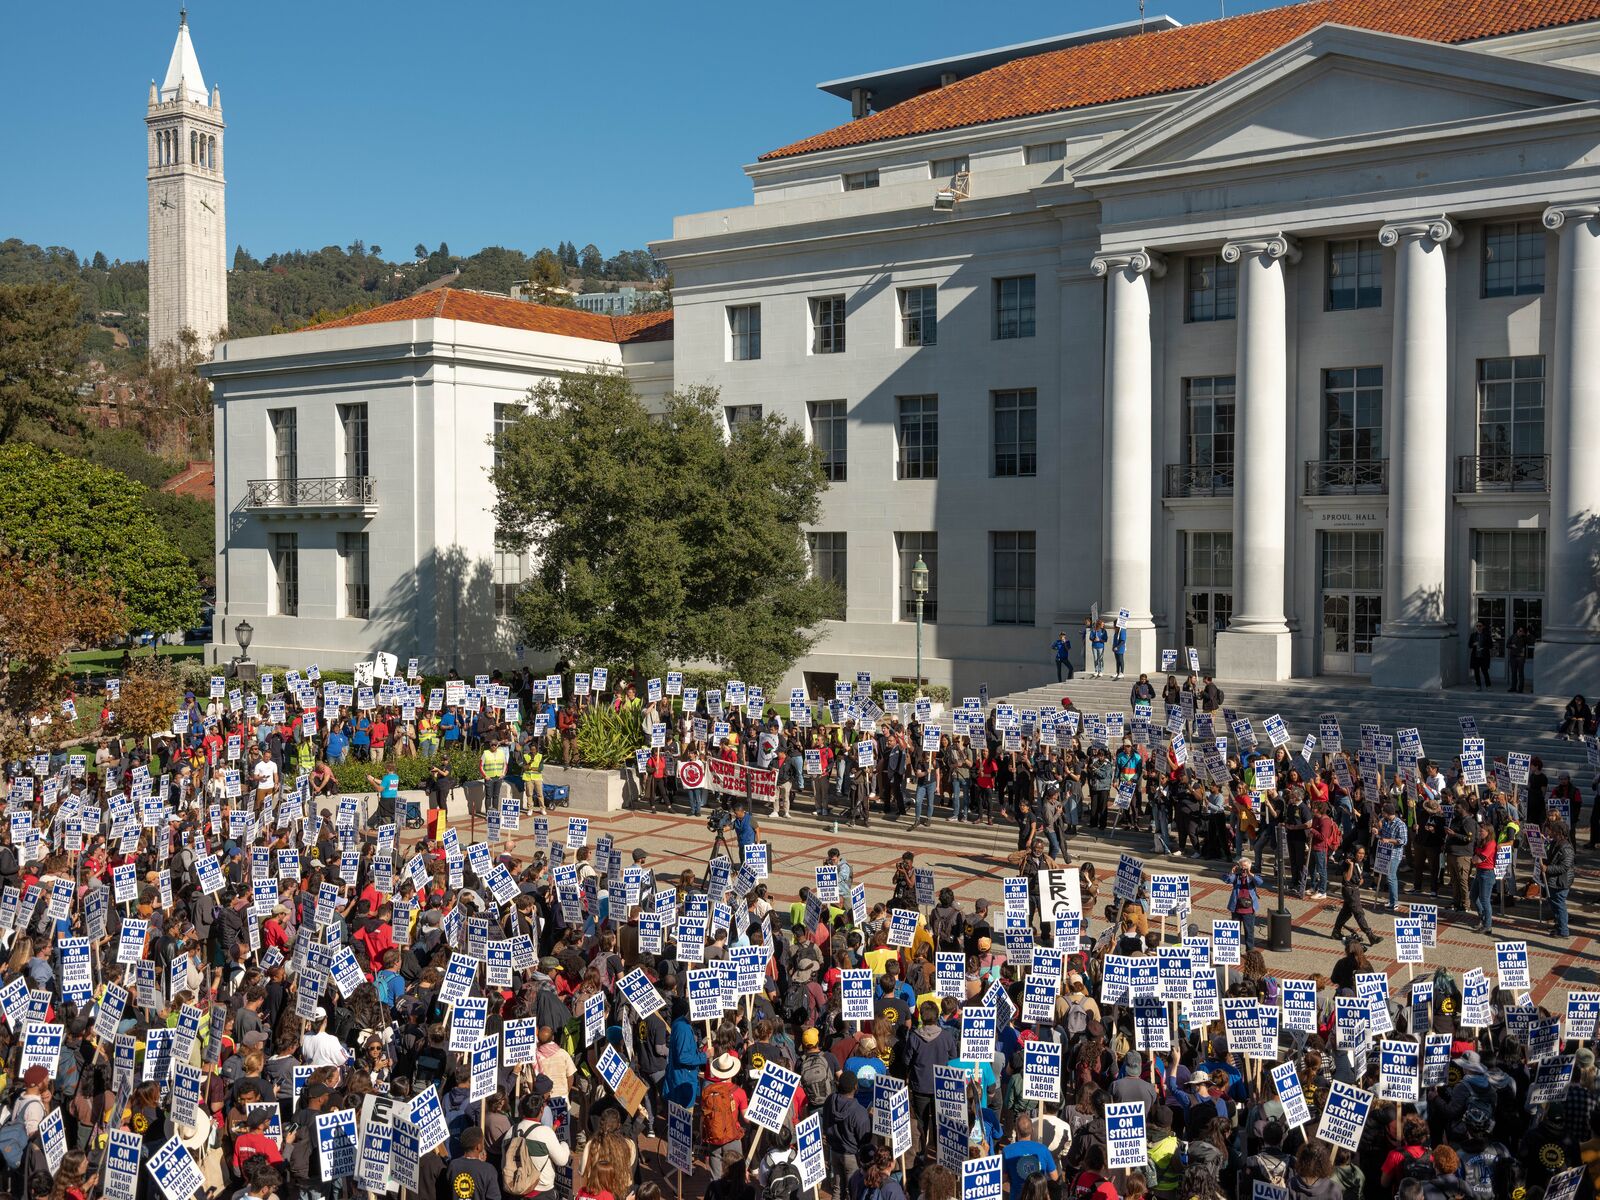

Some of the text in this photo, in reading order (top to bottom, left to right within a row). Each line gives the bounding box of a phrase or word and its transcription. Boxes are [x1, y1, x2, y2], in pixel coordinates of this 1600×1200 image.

[115, 865, 134, 874] UAW
[124, 920, 146, 928] UAW
[680, 918, 704, 927] UAW
[1214, 921, 1238, 929] UAW
[121, 936, 144, 944] STRIKE
[679, 934, 703, 943] STRIKE
[1159, 948, 1189, 957] UAW
[1497, 943, 1525, 951] UAW
[1499, 961, 1527, 969] STRIKE
[688, 970, 717, 981] UAW
[1160, 969, 1190, 977] STRIKE
[698, 981, 710, 989] ON
[690, 988, 719, 999] STRIKE
[843, 989, 872, 998] STRIKE
[695, 997, 717, 1006] UNFAIR
[696, 1003, 716, 1011] LABOR
[1135, 998, 1166, 1006] UAW
[1224, 999, 1257, 1008] UAW
[692, 1008, 721, 1019] PRACTICE
[964, 1008, 995, 1017] UAW
[1145, 1009, 1158, 1017] ON
[506, 1019, 534, 1030] UAW
[1137, 1018, 1167, 1026] STRIKE
[1227, 1019, 1258, 1028] STRIKE
[515, 1029, 526, 1037] ON
[964, 1029, 994, 1037] STRIKE
[473, 1036, 497, 1052] UAW
[506, 1036, 534, 1046] STRIKE
[1229, 1042, 1260, 1050] PRACTICE
[509, 1044, 531, 1053] UNFAIR
[1026, 1042, 1060, 1054] UAW
[1382, 1042, 1417, 1054] UAW
[480, 1050, 490, 1061] ON
[510, 1050, 530, 1058] LABOR
[962, 1052, 993, 1060] PRACTICE
[1393, 1055, 1407, 1064] ON
[505, 1056, 535, 1065] PRACTICE
[1036, 1055, 1050, 1065] ON
[473, 1058, 496, 1075] STRIKE
[1026, 1064, 1059, 1076] STRIKE
[1382, 1064, 1417, 1076] STRIKE
[475, 1069, 494, 1083] UNFAIR
[764, 1063, 798, 1085] UAW
[1029, 1075, 1055, 1084] UNFAIR
[1386, 1075, 1413, 1084] UNFAIR
[476, 1077, 492, 1090] LABOR
[770, 1079, 785, 1092] ON
[1031, 1082, 1053, 1091] LABOR
[1387, 1083, 1411, 1091] LABOR
[471, 1083, 496, 1099] PRACTICE
[756, 1084, 790, 1107] STRIKE
[1025, 1089, 1058, 1099] PRACTICE
[1332, 1083, 1371, 1103] UAW
[1380, 1089, 1417, 1099] PRACTICE
[756, 1096, 782, 1114] UNFAIR
[1107, 1104, 1142, 1116] UAW
[1340, 1098, 1357, 1111] ON
[755, 1104, 778, 1120] LABOR
[1326, 1104, 1364, 1125] STRIKE
[747, 1108, 780, 1130] PRACTICE
[1119, 1118, 1133, 1127] ON
[1328, 1115, 1357, 1132] UNFAIR
[394, 1117, 418, 1138] UAW
[1327, 1123, 1353, 1138] LABOR
[1109, 1127, 1144, 1140] STRIKE
[1319, 1128, 1356, 1148] PRACTICE
[111, 1131, 141, 1148] UAW
[401, 1134, 411, 1148] ON
[1113, 1139, 1141, 1149] UNFAIR
[118, 1148, 131, 1160] ON
[393, 1142, 418, 1163] STRIKE
[1115, 1148, 1140, 1157] LABOR
[108, 1157, 138, 1174] STRIKE
[396, 1155, 415, 1172] UNFAIR
[1110, 1155, 1146, 1166] PRACTICE
[396, 1164, 413, 1179] LABOR
[110, 1171, 133, 1184] UNFAIR
[392, 1170, 417, 1190] PRACTICE
[111, 1180, 131, 1192] LABOR
[104, 1187, 135, 1200] PRACTICE
